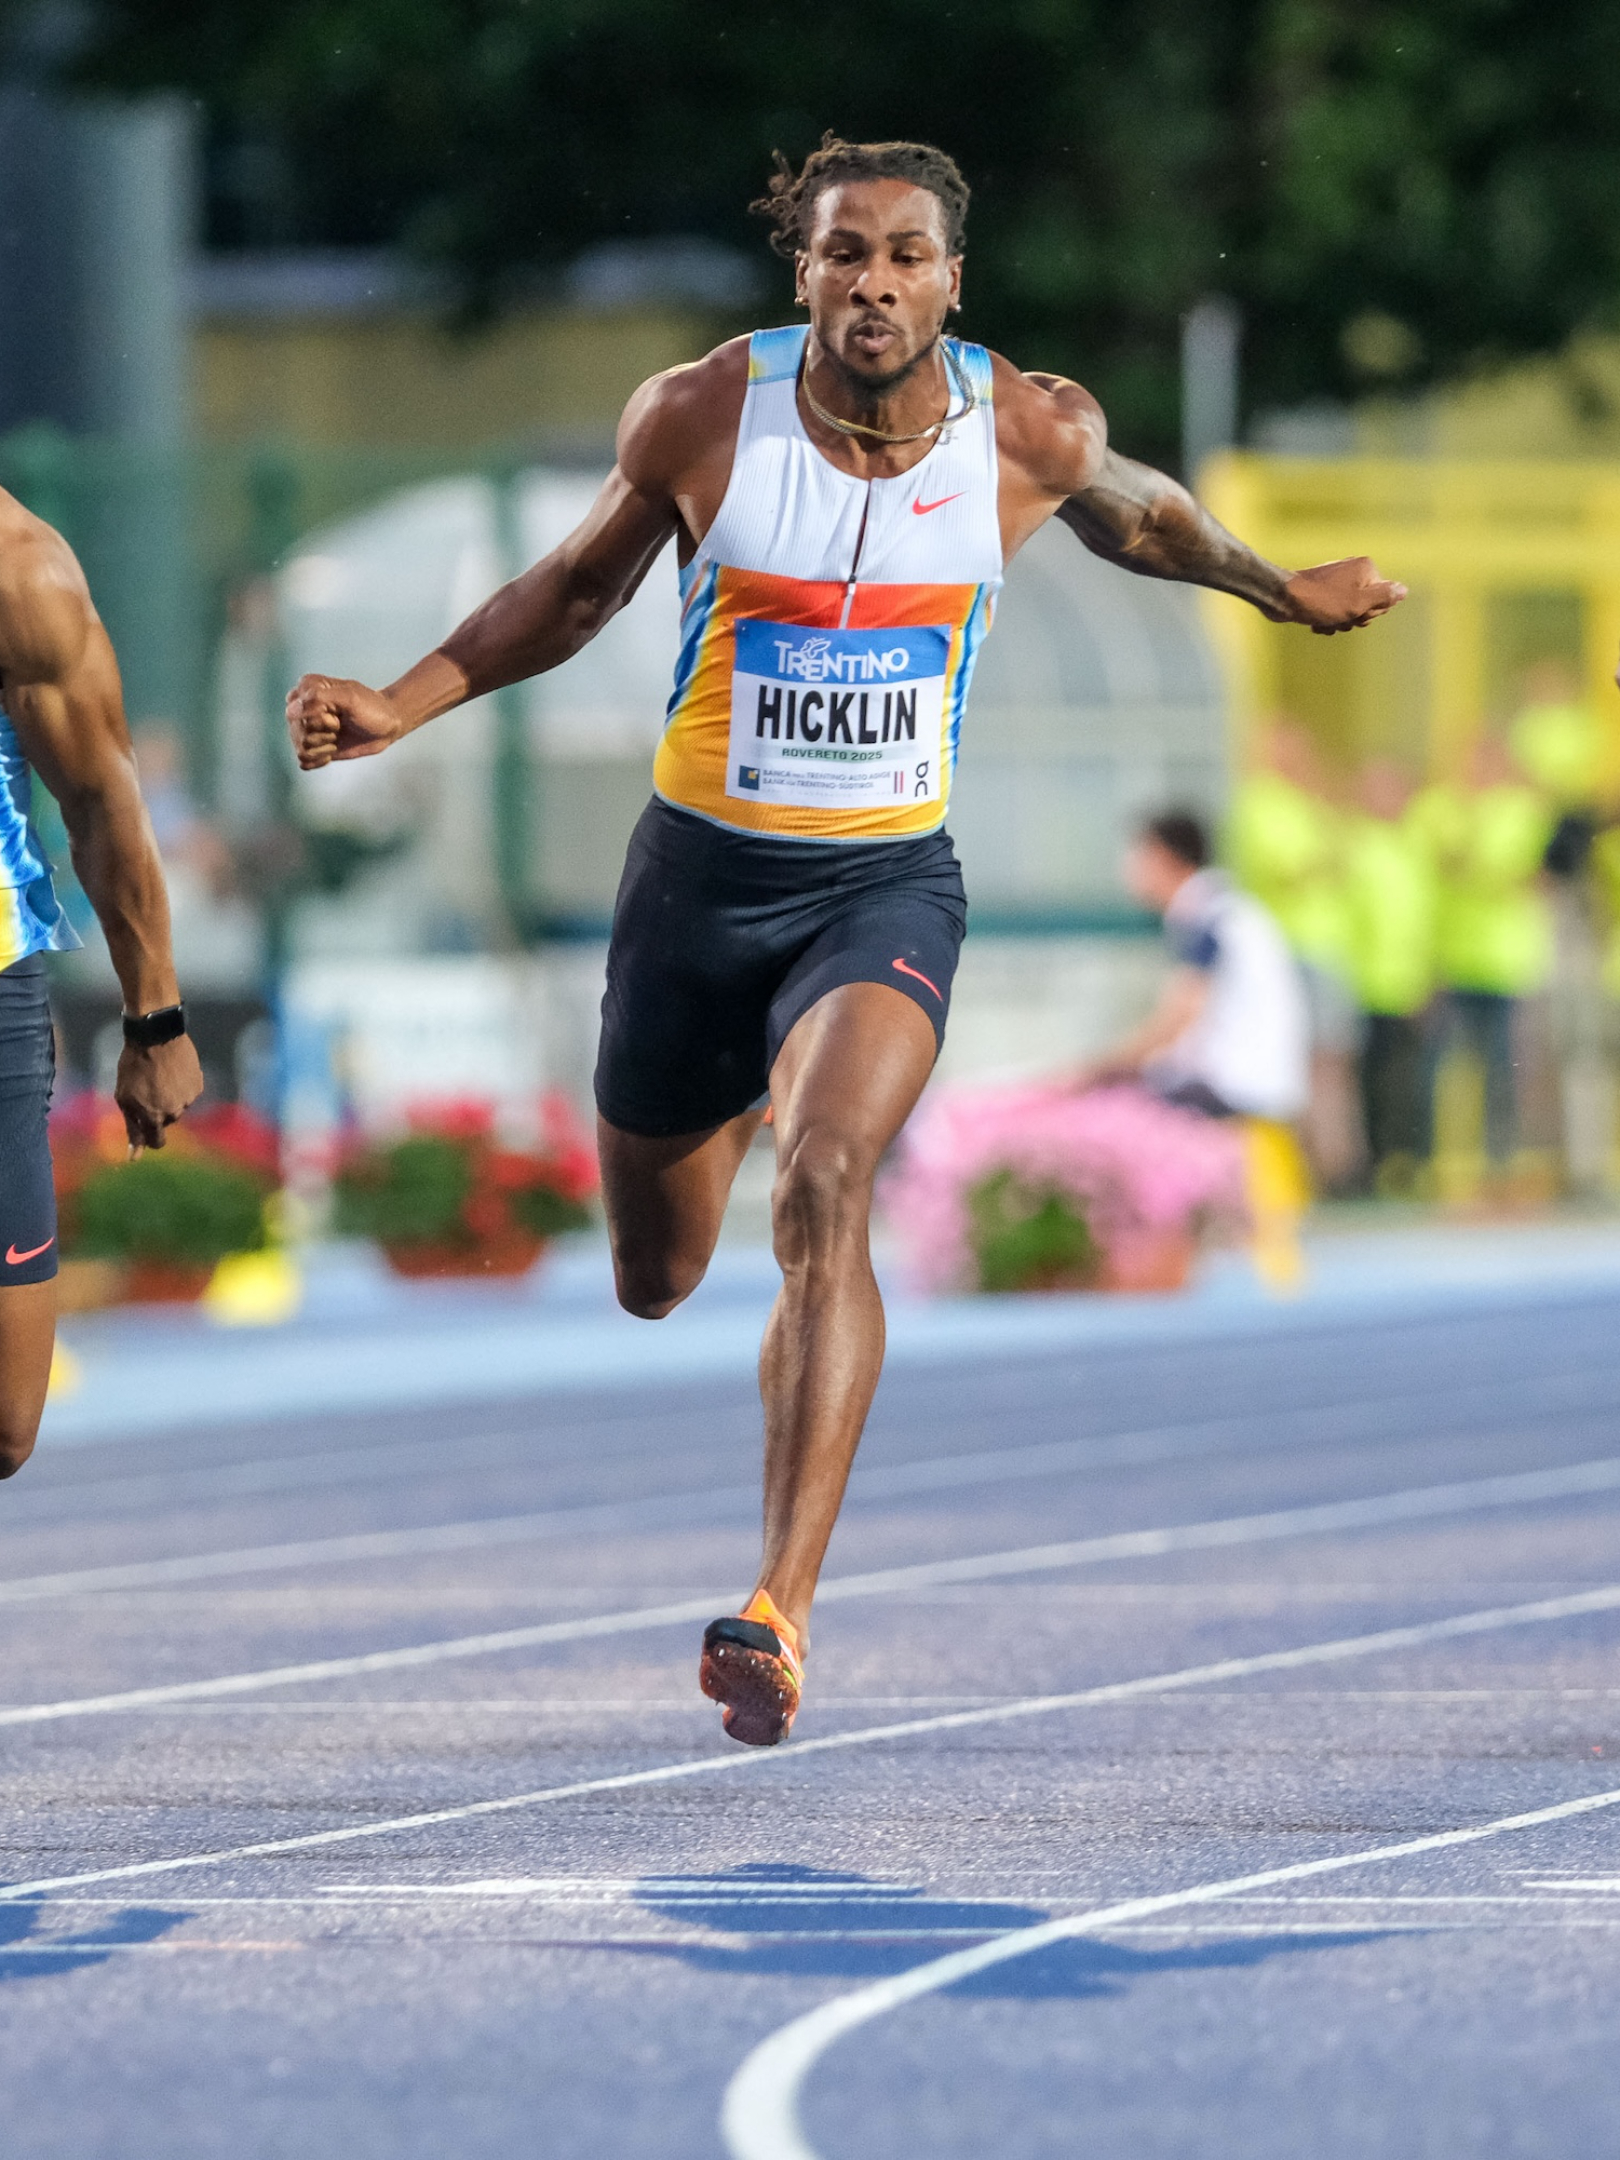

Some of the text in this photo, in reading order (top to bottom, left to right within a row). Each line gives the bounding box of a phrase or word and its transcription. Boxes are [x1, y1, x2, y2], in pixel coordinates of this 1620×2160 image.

[774, 640, 909, 682] TRENTINO
[756, 685, 917, 744] HICKLIN
[782, 748, 883, 761] ROVERETO 2025
